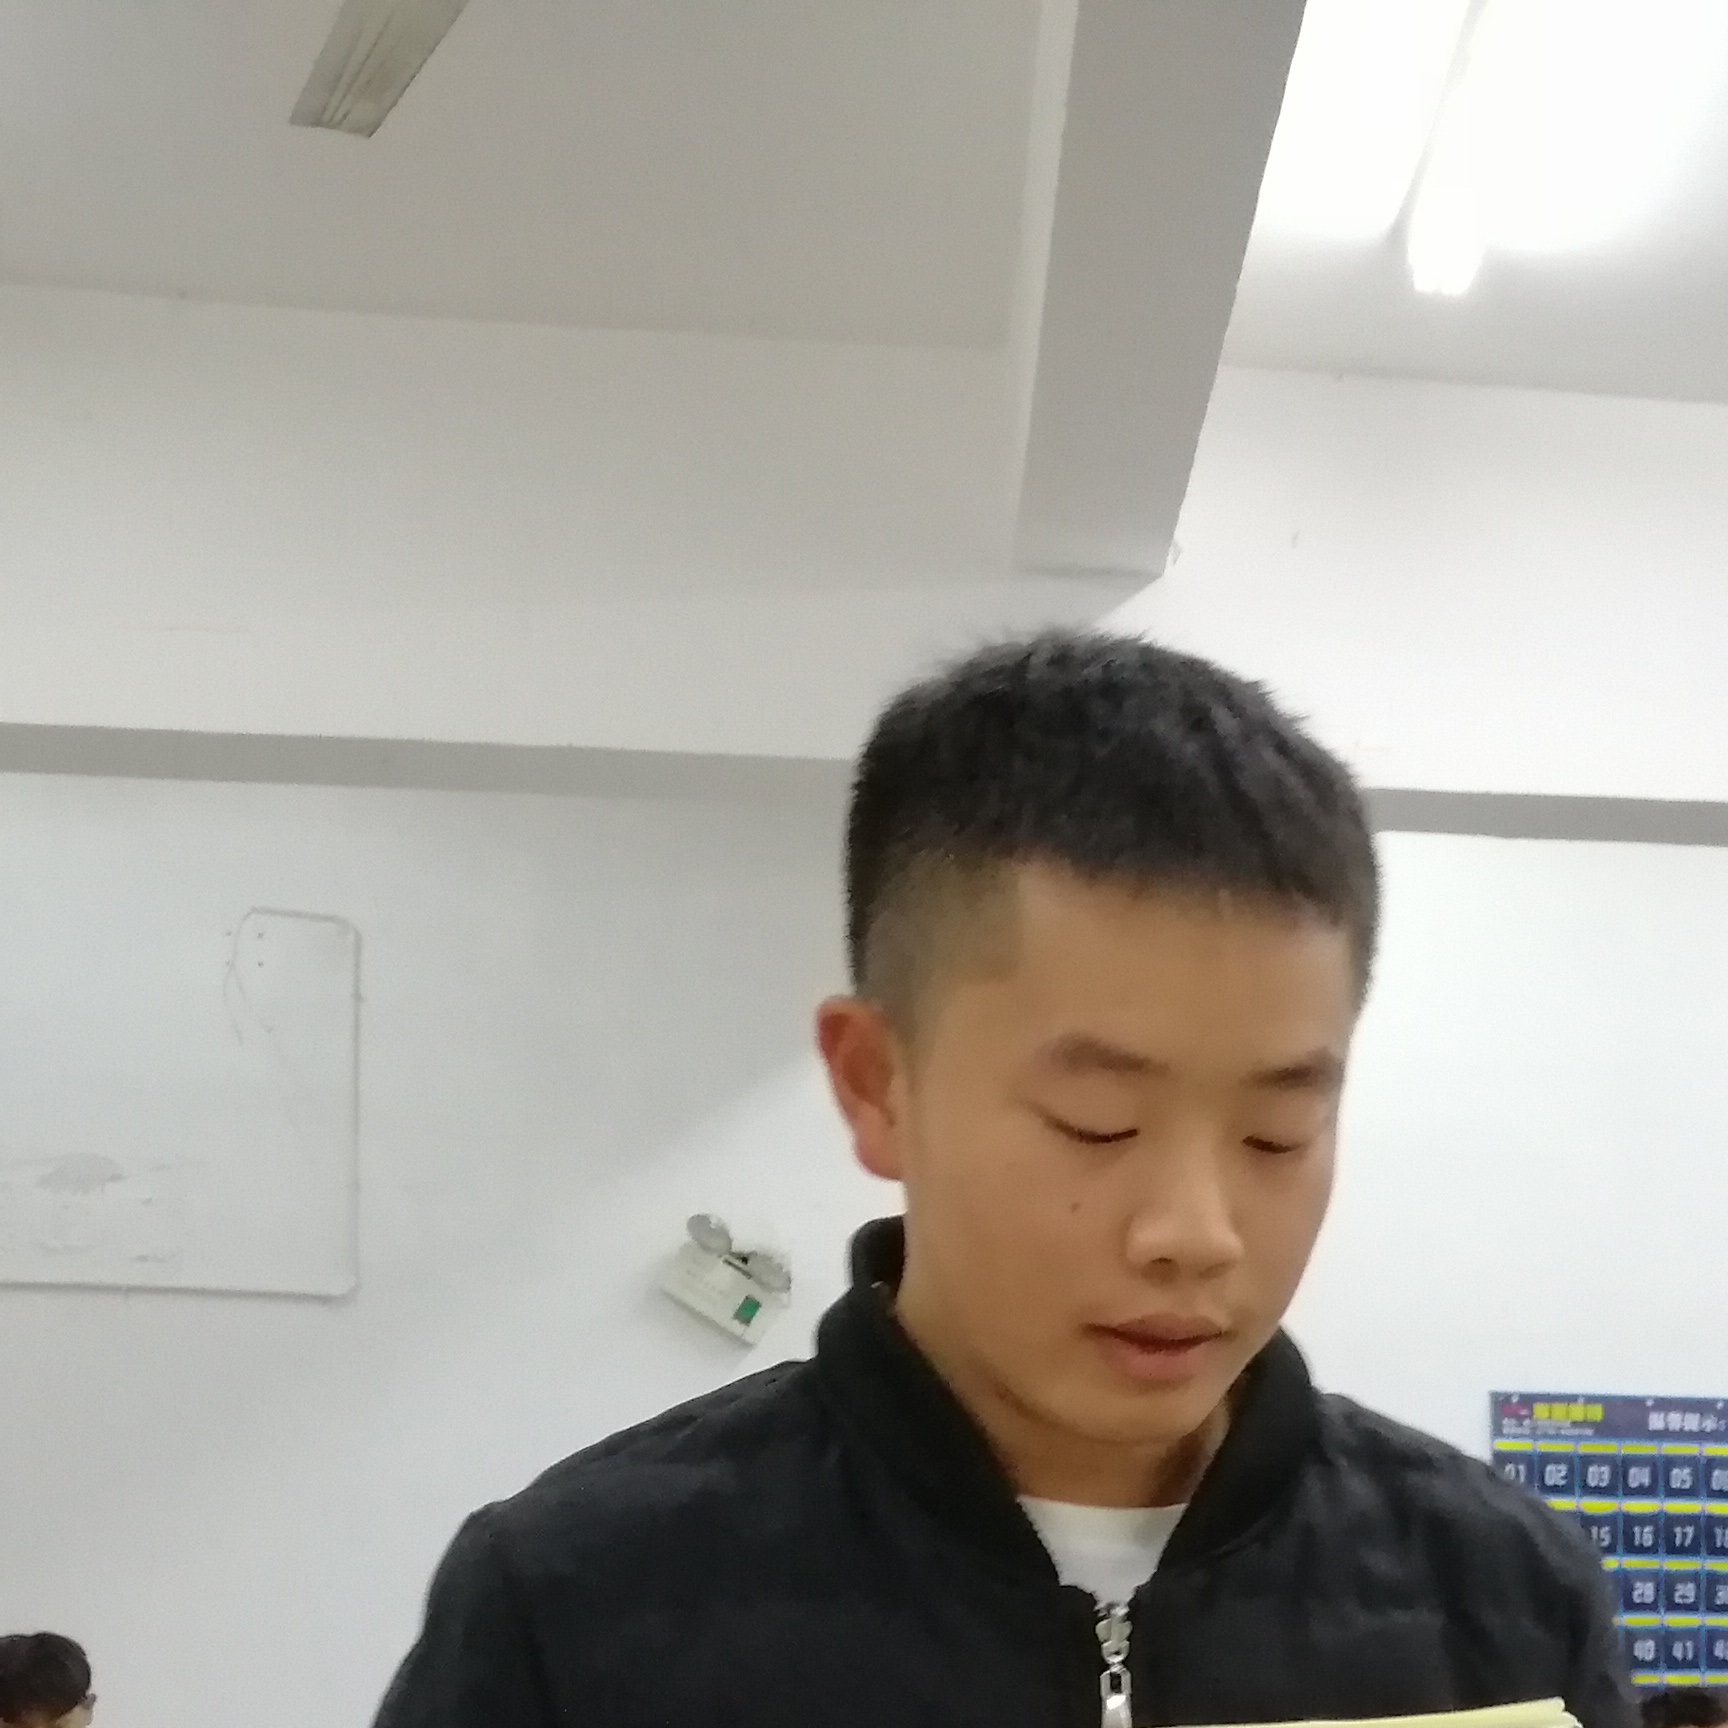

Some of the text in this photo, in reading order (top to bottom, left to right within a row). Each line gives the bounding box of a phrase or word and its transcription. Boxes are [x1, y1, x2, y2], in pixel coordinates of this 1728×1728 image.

[1544, 1463, 1568, 1487] 02
[1587, 1464, 1611, 1487] 03
[1628, 1466, 1651, 1489] 04
[1669, 1467, 1693, 1489] 05
[1590, 1525, 1612, 1547] 15
[1633, 1525, 1654, 1548] 16
[1673, 1525, 1694, 1548] 17
[1674, 1581, 1696, 1604] 29
[1672, 1640, 1694, 1662] 41
